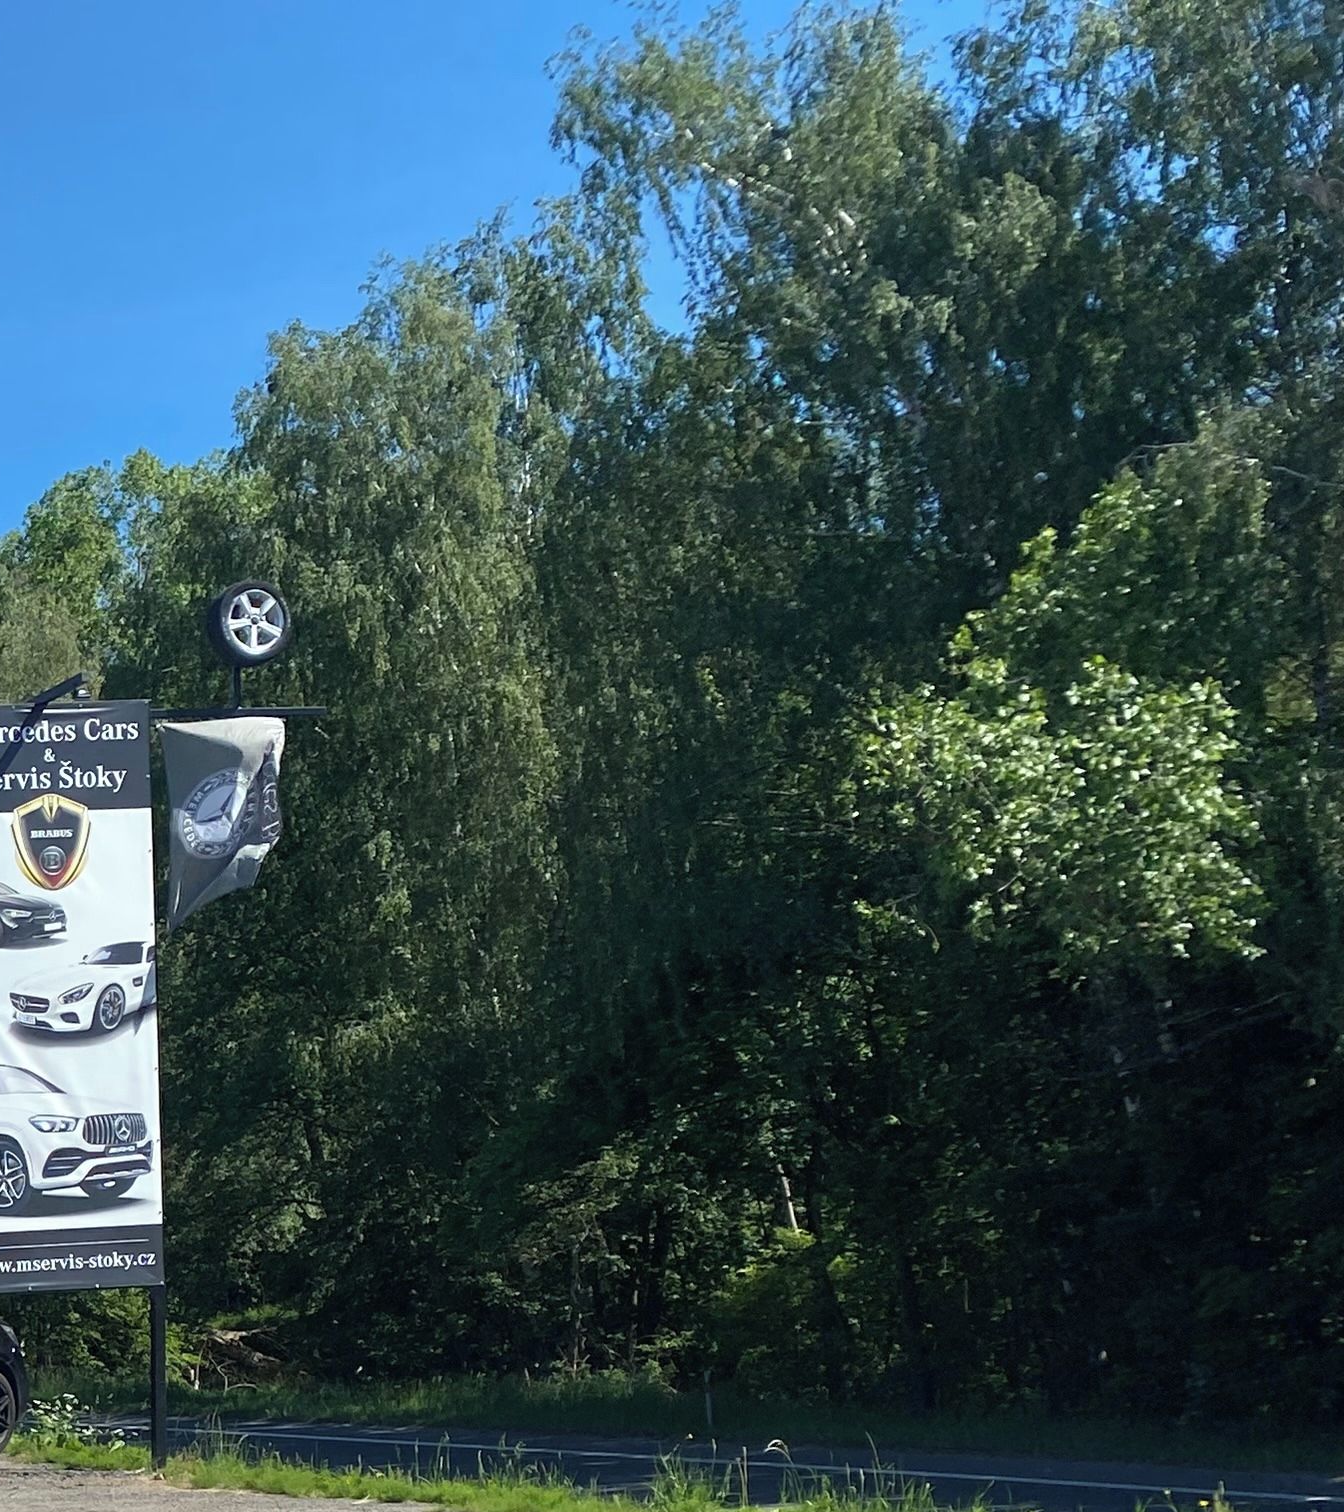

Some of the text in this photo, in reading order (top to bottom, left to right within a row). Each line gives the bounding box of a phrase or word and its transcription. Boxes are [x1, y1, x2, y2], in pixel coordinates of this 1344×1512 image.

[83, 718, 140, 741] Cars
[43, 748, 56, 763] &
[58, 760, 128, 793] Štoky
[30, 829, 74, 839] BRABUS
